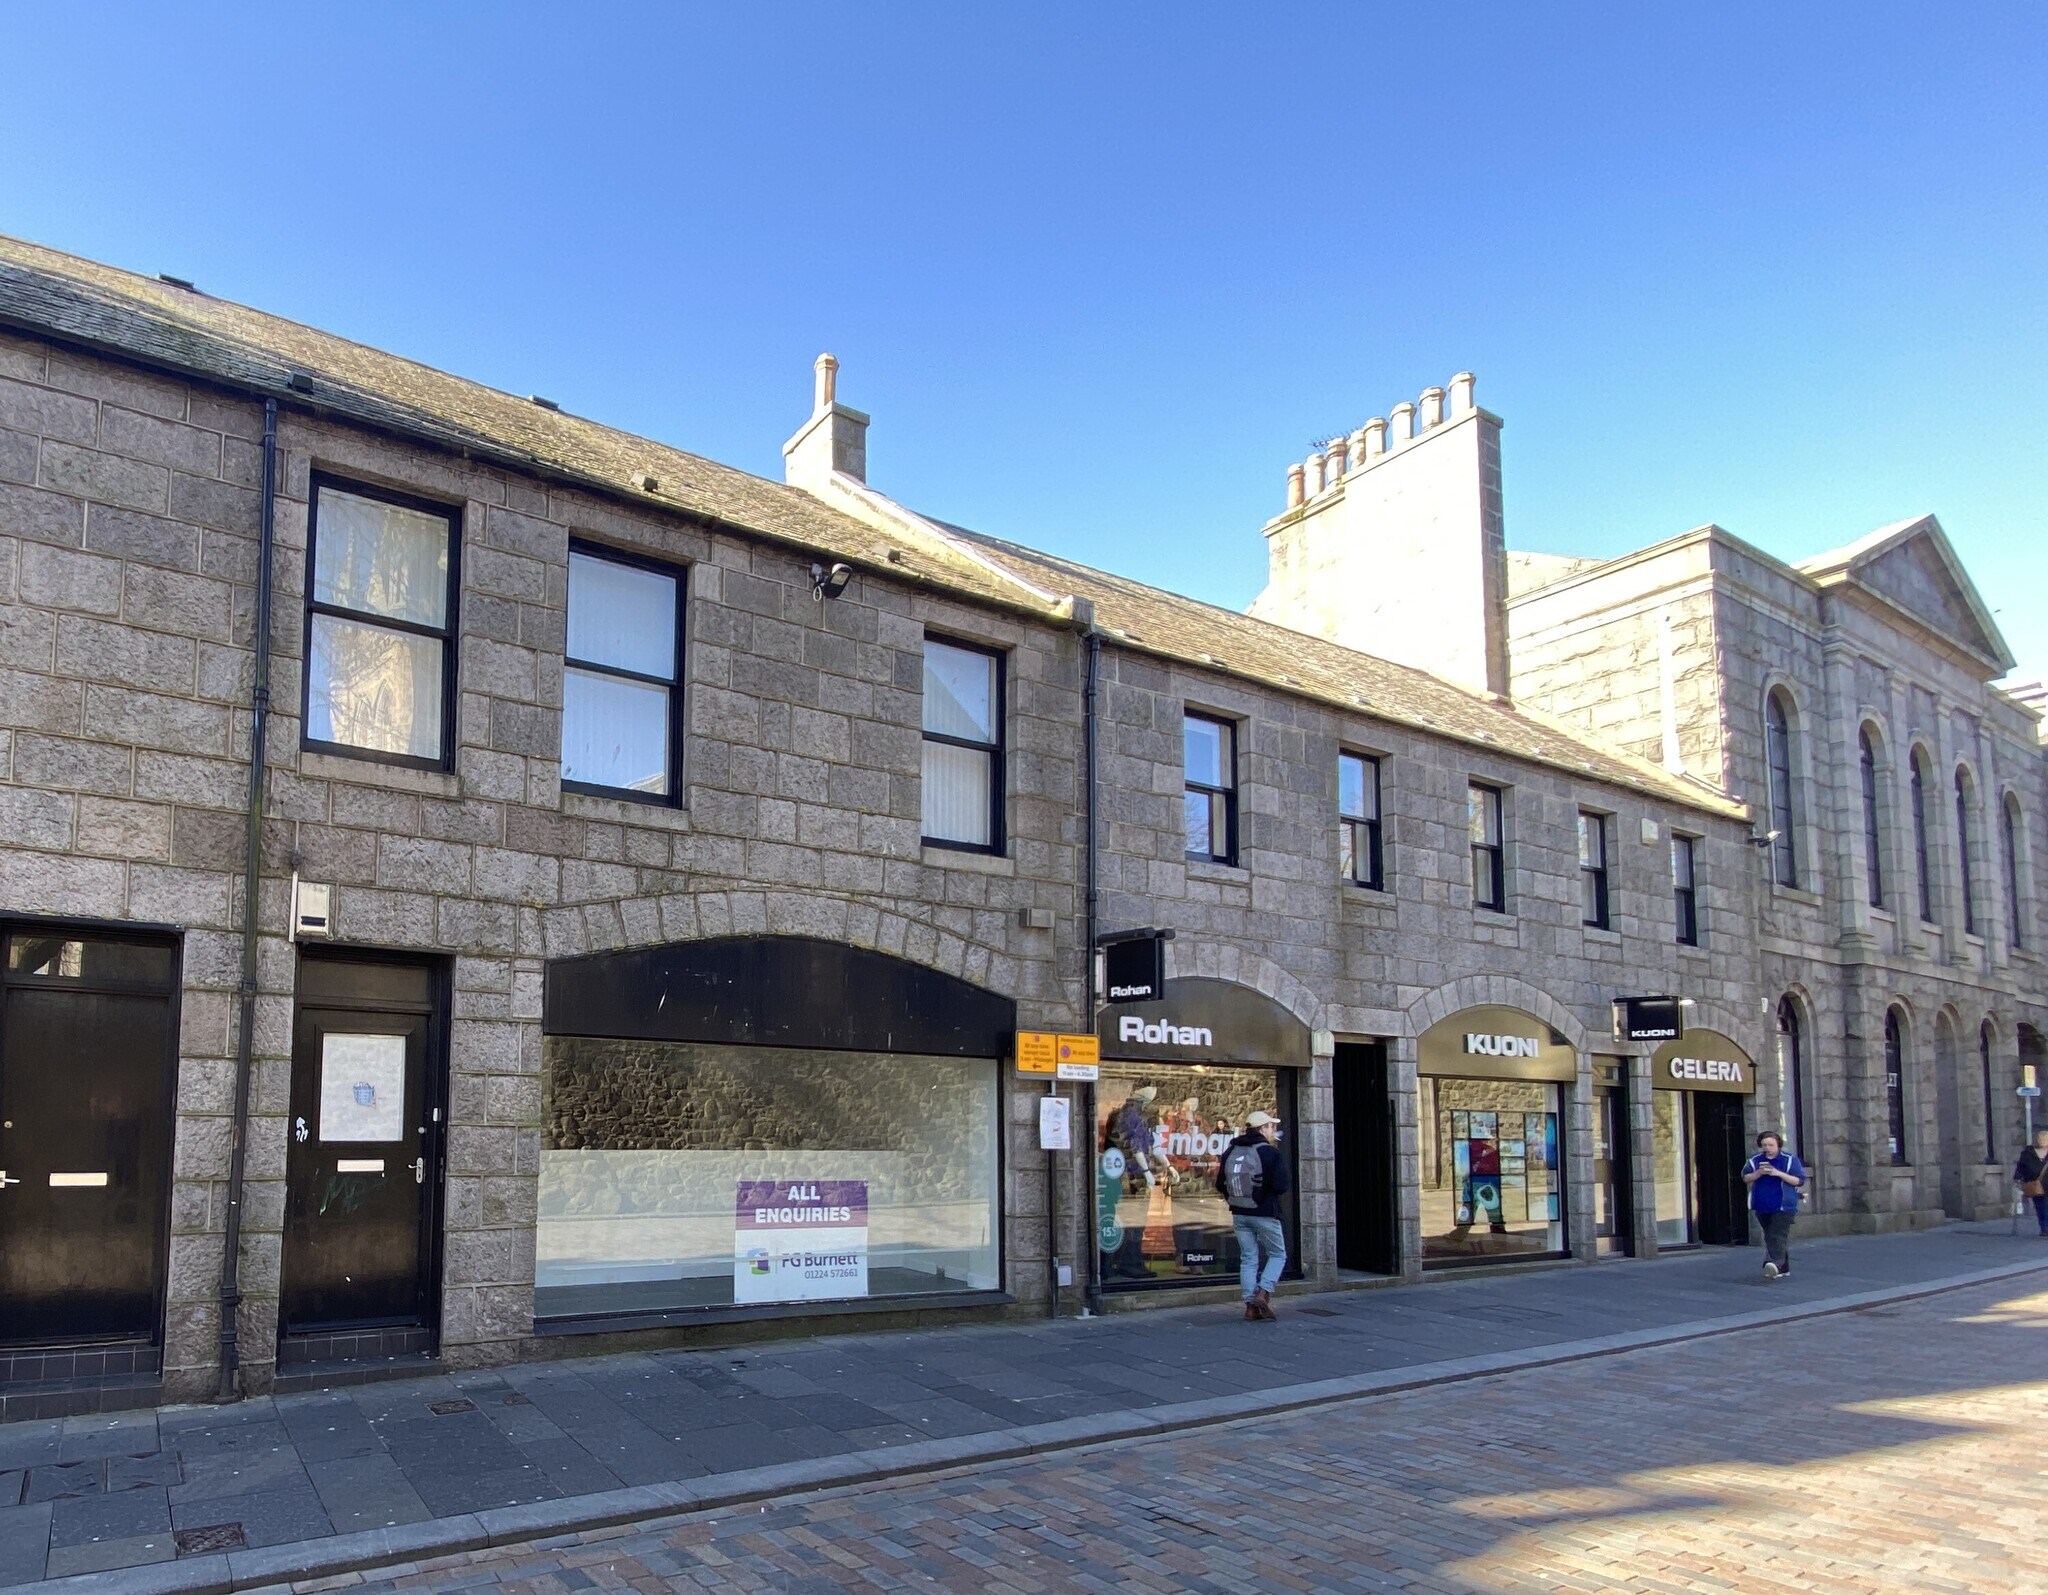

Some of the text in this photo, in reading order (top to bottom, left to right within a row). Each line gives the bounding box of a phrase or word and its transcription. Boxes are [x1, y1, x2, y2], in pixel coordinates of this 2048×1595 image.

[1110, 984, 1152, 997] Rohan
[1119, 1015, 1213, 1047] Rohan
[1630, 1028, 1676, 1038] KUONI
[1465, 1033, 1540, 1058] KUONI
[1669, 1057, 1743, 1082] CELERA
[787, 1185, 821, 1201] ALL
[755, 1206, 851, 1224] ENQUIRIES
[782, 1252, 858, 1268] FG Burnett
[1186, 1253, 1214, 1262] Rohan
[804, 1268, 858, 1280] 01224 572661
